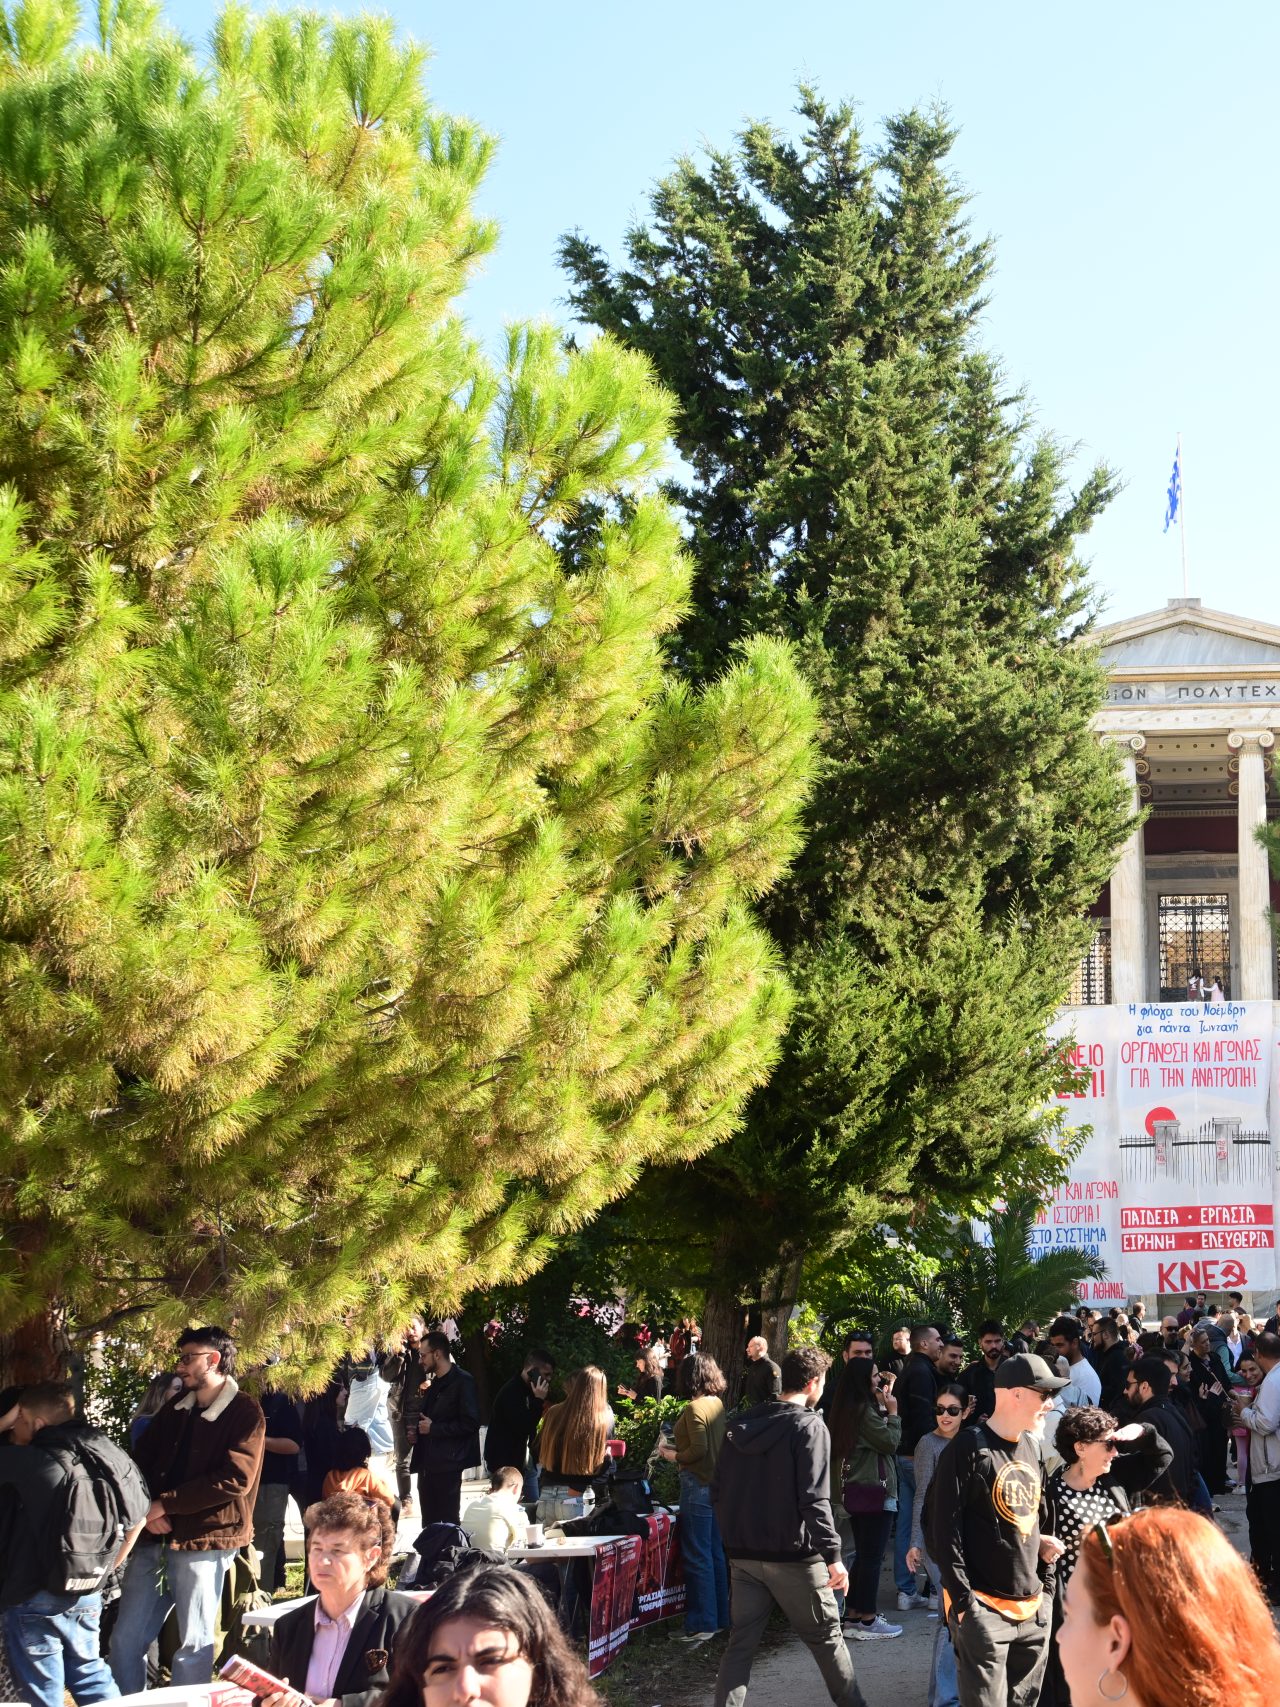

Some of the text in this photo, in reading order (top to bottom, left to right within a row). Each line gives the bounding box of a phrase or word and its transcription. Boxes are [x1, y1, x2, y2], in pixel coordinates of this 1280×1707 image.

[1129, 1002, 1246, 1020] Η φλόγα του Νοέμβρη
[1137, 1020, 1239, 1037] για πάντα ζωντανή
[1121, 1039, 1262, 1065] ΟΡΓΑΝΩΣΗ ΚΑΙ ΑΓΩΝΑΣ
[1130, 1069, 1150, 1089] ΓΙΑ
[1160, 1068, 1184, 1089] ΤΗΝ
[1066, 1182, 1082, 1200] ΚΑΙ
[1085, 1180, 1119, 1200] ΑΓΩΝΑ
[1122, 1206, 1256, 1226] ΠΑΙΔΕΙΑ ΕΡΓΑΣΙΑ
[1055, 1227, 1107, 1243] ΣΥΣΤΗΜΑ
[1123, 1231, 1269, 1250] ΕΙΡΗΝΗ ΕΛΕΥΘΕΡΙΑ
[1158, 1259, 1220, 1293] ΚΝΕ
[1093, 1282, 1127, 1300] ΑΘΗΝΑΣ
